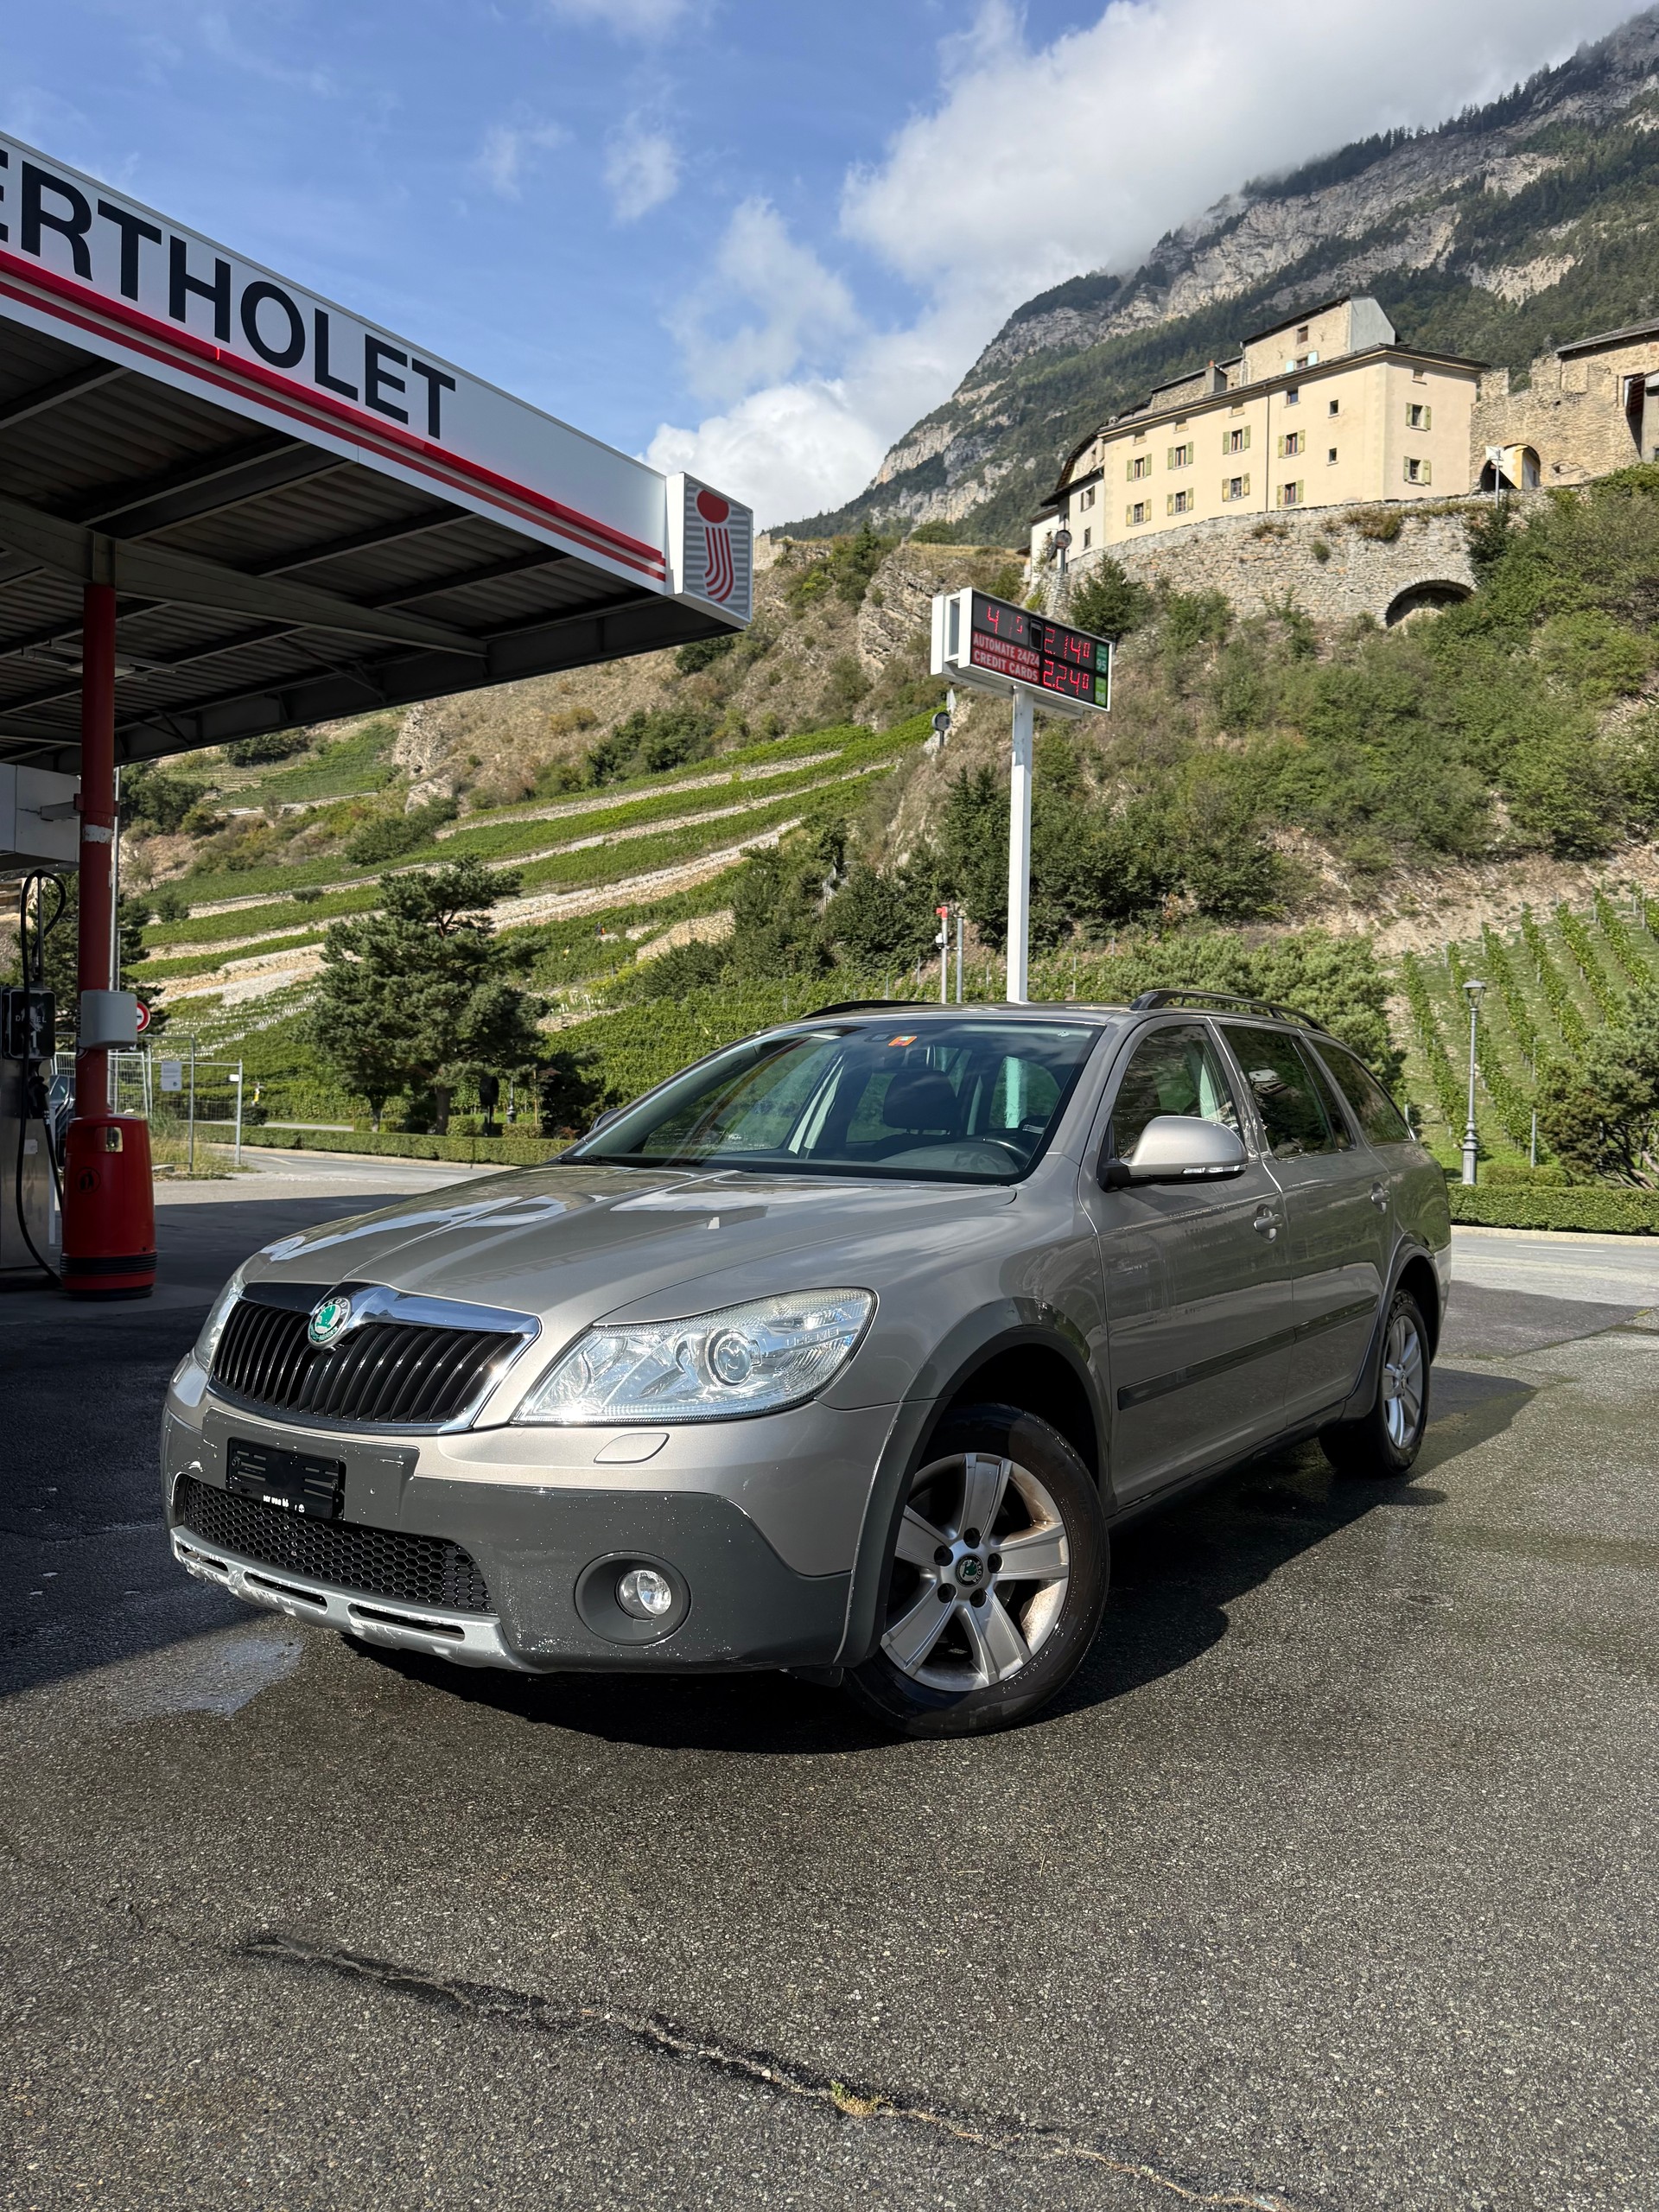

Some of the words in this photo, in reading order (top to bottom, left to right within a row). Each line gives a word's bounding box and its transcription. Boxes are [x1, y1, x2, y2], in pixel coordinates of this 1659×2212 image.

[0, 149, 456, 440] RTHOLET
[973, 632, 1015, 658] AUTOMATE
[1017, 649, 1040, 668] 24/24
[974, 650, 1007, 671] CREDIT
[1009, 662, 1039, 682] CARDS
[1096, 658, 1107, 672] 95
[15, 1014, 47, 1023] DISEL
